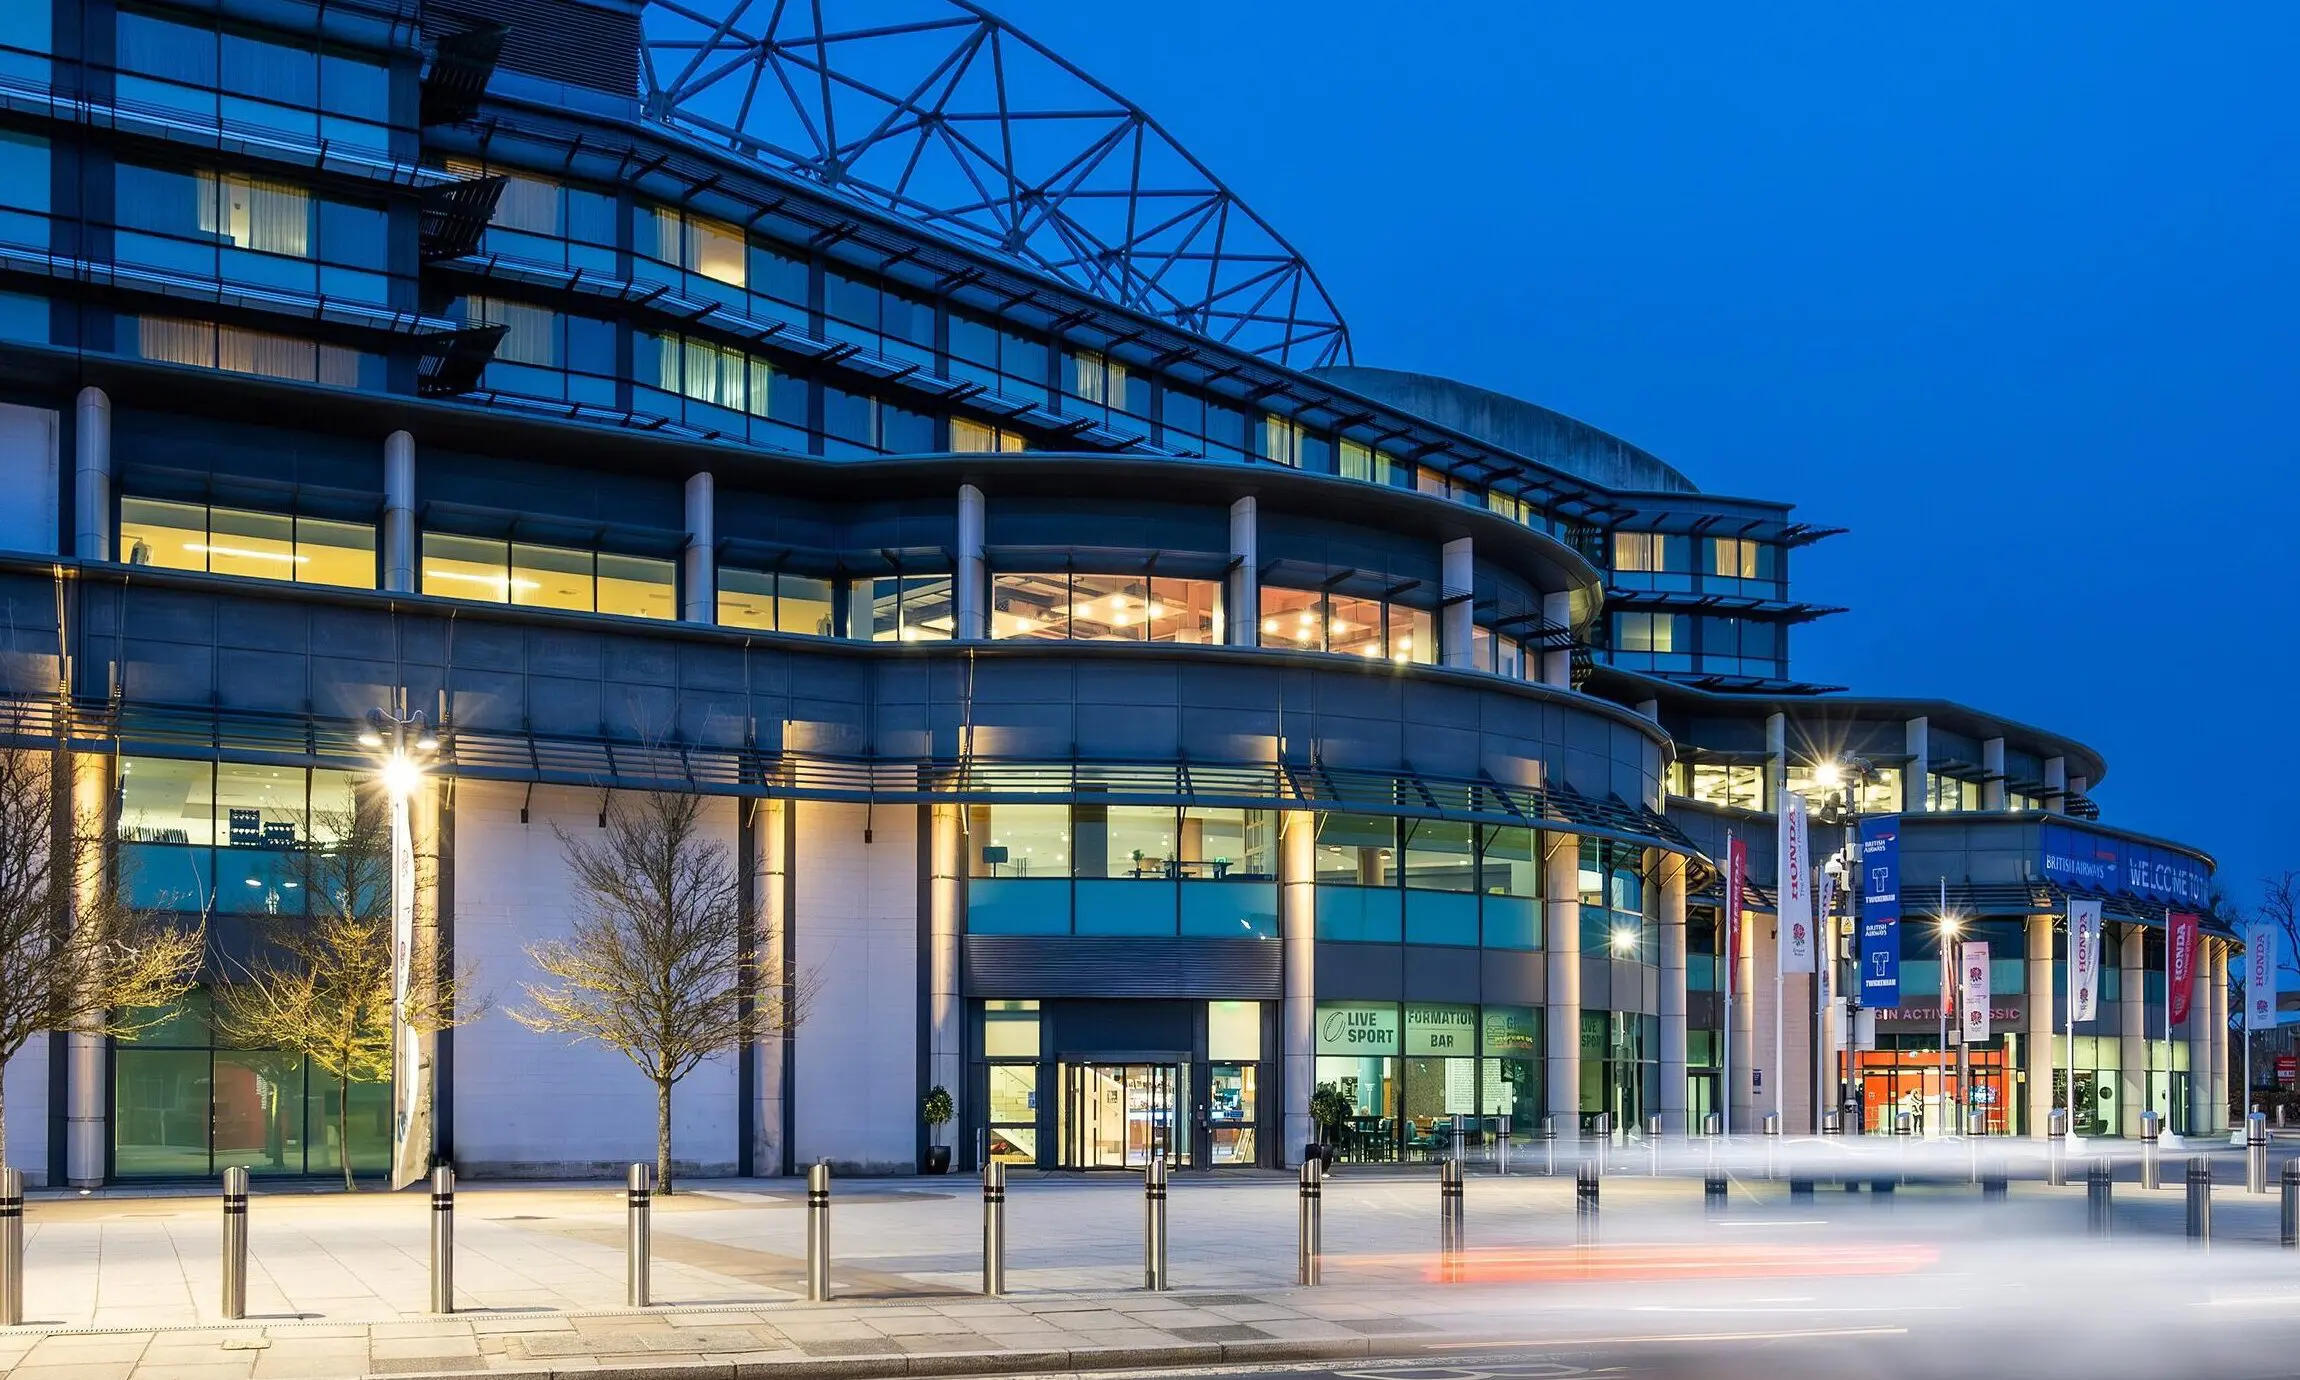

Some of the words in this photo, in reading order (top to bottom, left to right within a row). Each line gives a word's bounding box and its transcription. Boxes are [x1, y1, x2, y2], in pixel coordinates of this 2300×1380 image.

[1788, 808, 1798, 901] HONDA
[2046, 854, 2075, 874] BRITISH
[2075, 860, 2104, 879] AIRWAYS
[2129, 858, 2187, 896] WELCOME
[2189, 872, 2200, 900] TO
[2079, 911, 2088, 973] HONDA
[2175, 923, 2186, 981] HONDA
[2255, 933, 2265, 987] HONDA
[1347, 1012, 1377, 1027] LIVE
[1408, 1010, 1475, 1025] FORMATION
[1875, 1009, 1898, 1020] GIN
[1903, 1009, 1953, 1020] ACTIV
[1347, 1029, 1394, 1043] SPORT
[1430, 1034, 1454, 1047] BAR
